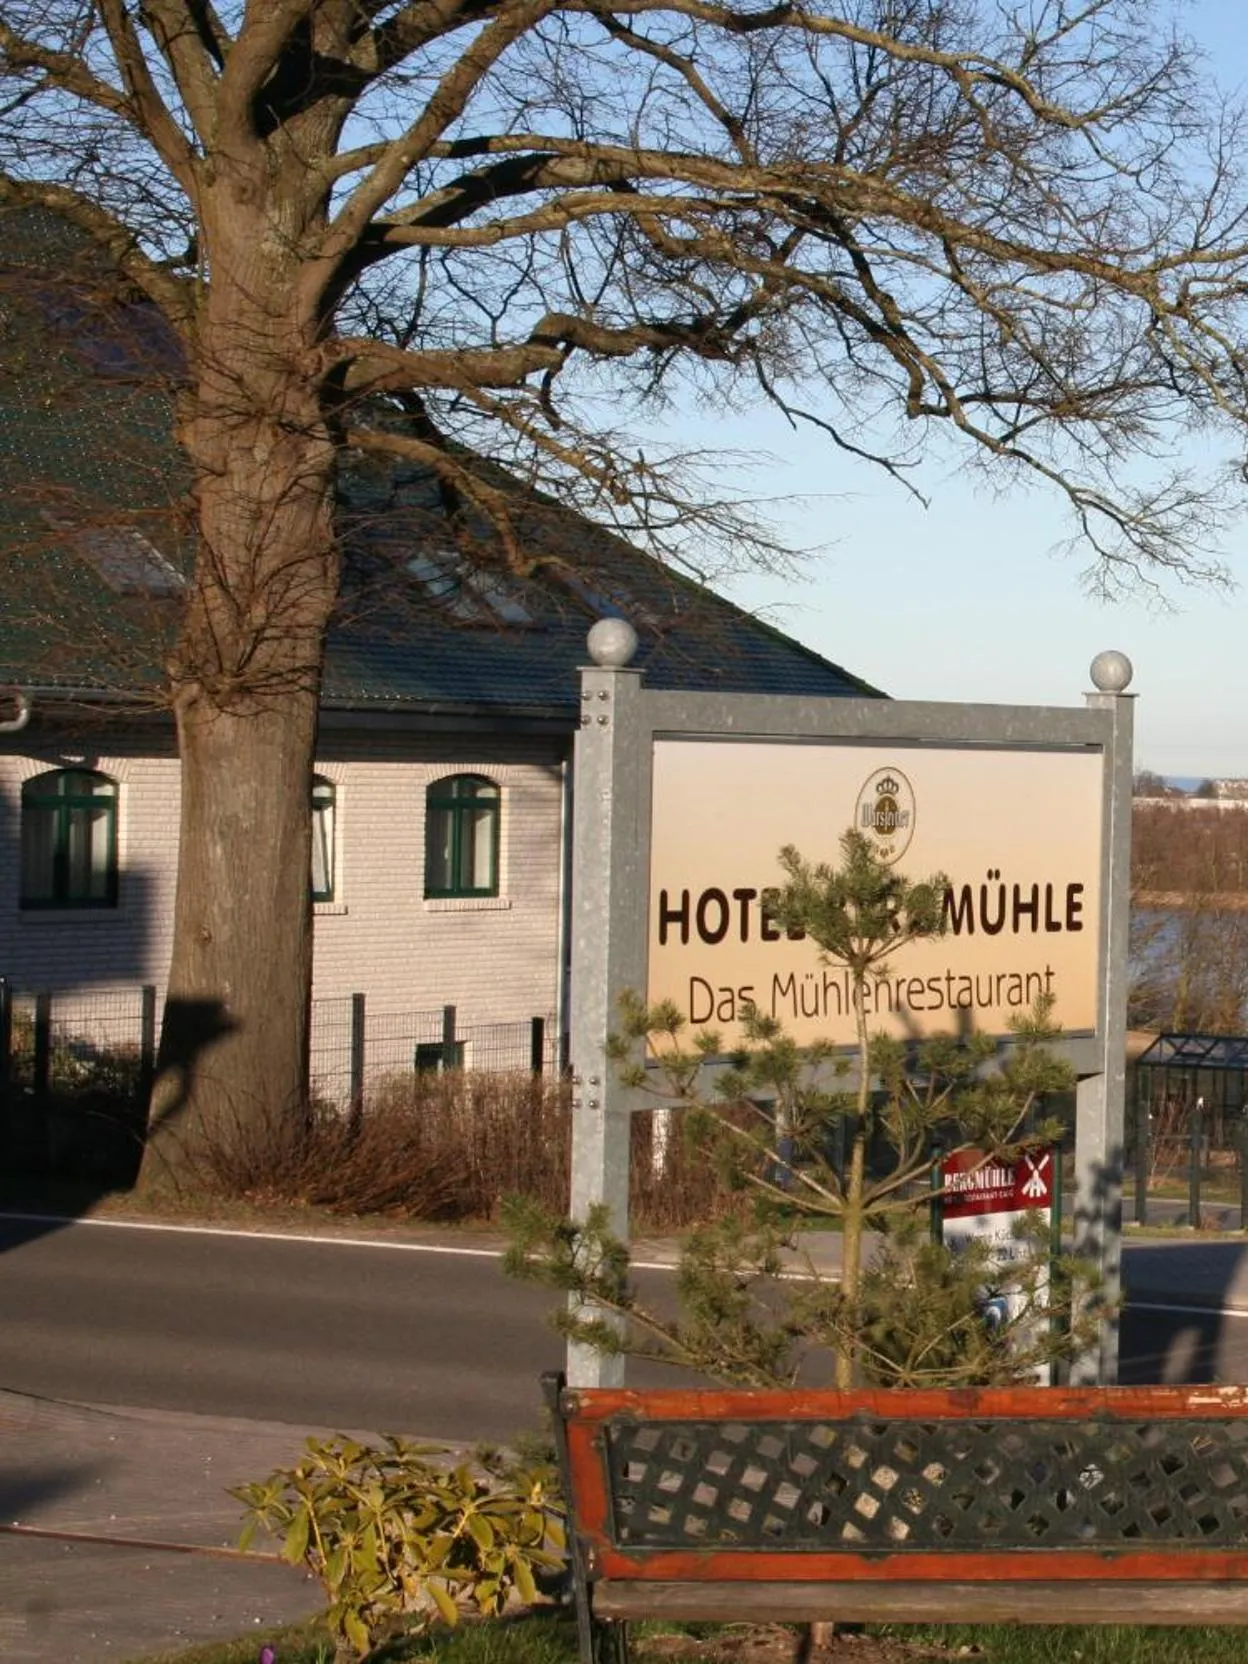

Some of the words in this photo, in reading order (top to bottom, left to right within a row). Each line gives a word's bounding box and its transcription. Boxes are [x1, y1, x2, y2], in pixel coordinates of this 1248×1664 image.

[823, 868, 1084, 939] MÜHLE
[689, 976, 755, 1025] Das
[771, 964, 1056, 1019] Mühlenrestaurant
